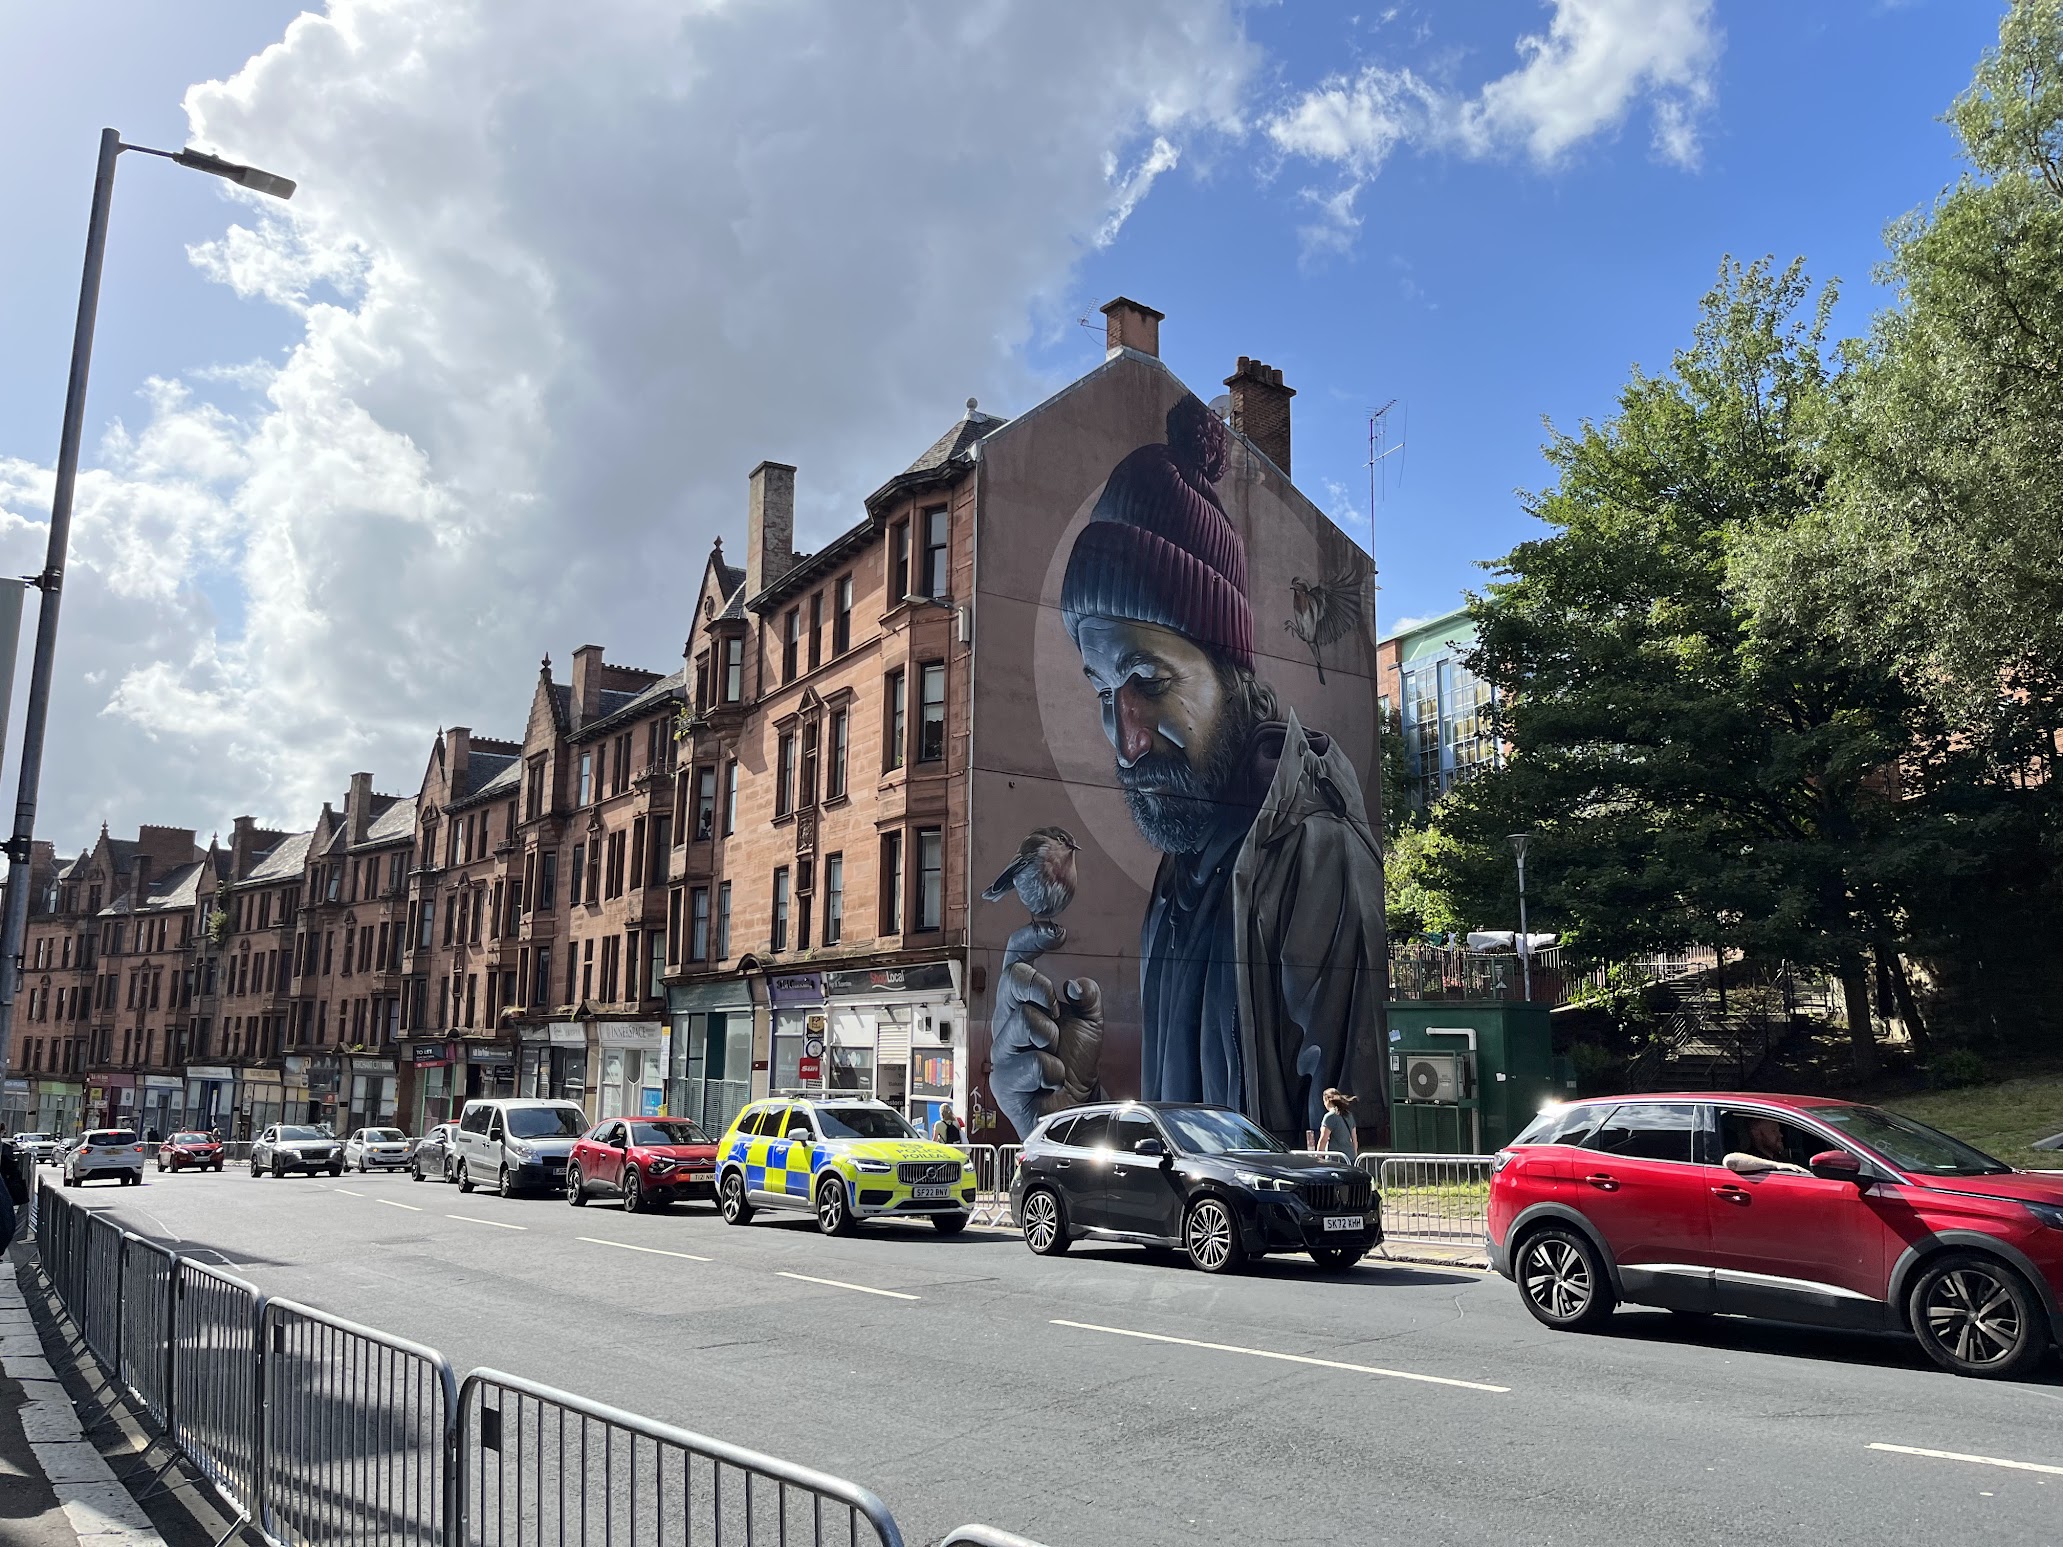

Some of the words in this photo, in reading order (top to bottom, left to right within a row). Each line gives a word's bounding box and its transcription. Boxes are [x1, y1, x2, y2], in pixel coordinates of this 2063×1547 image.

[870, 969, 905, 984] ShopLocal
[917, 1188, 934, 1197] SF22
[1327, 1218, 1347, 1229] SK72
